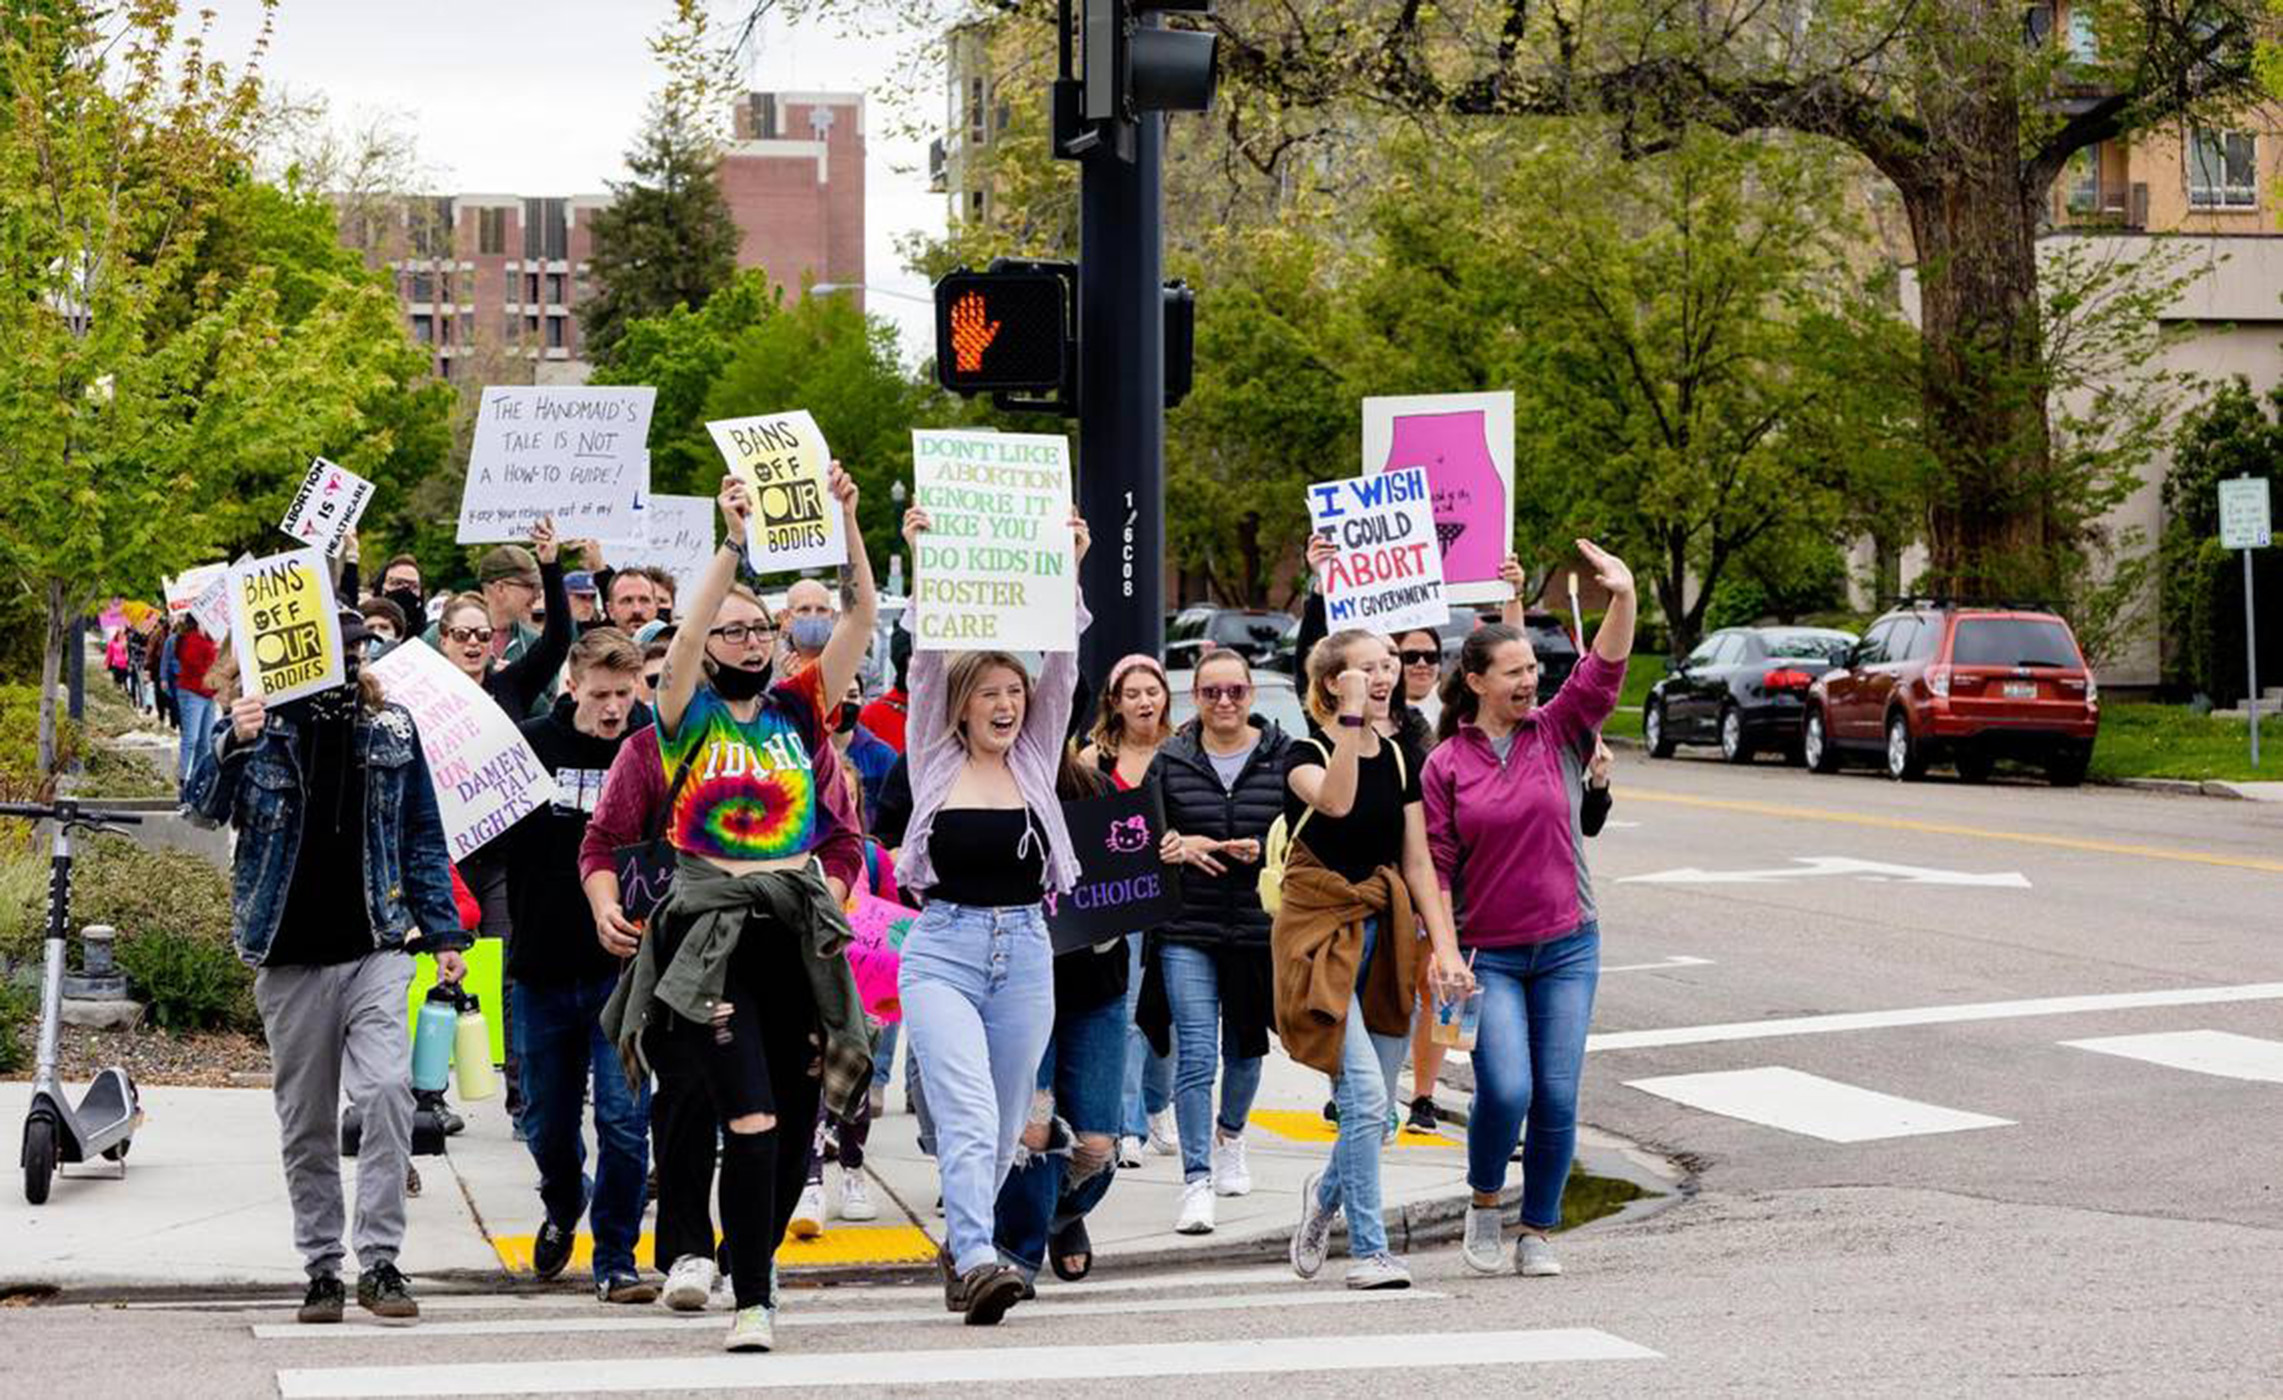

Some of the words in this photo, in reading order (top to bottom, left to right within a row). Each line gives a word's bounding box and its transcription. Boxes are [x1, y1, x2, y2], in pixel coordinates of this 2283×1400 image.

[492, 396, 523, 421] THE
[534, 396, 638, 422] HANDMAID'S
[503, 431, 543, 451] TALE
[554, 431, 568, 449] IS
[577, 431, 619, 452] NOT
[729, 421, 799, 457] BANS
[1000, 444, 1059, 465] LIKE
[480, 467, 491, 484] A
[570, 463, 624, 485] GUIDE!
[935, 462, 1062, 489] ABORTION
[284, 460, 326, 533] ABORTION
[317, 501, 336, 519] IS
[759, 481, 823, 523] OUR
[918, 486, 1013, 515] IGNORE
[1024, 496, 1052, 516] IT
[1313, 486, 1345, 518] I
[1350, 469, 1425, 509] WISH
[768, 523, 826, 553] BODIES
[989, 516, 1040, 541] YOU
[1343, 510, 1412, 550] COULD
[921, 547, 960, 570] DO
[967, 548, 1029, 573] KIDS
[1034, 550, 1064, 576] IN
[1327, 542, 1430, 594] ABORT
[243, 558, 305, 606] BANS
[921, 578, 1027, 606] FOSTER
[921, 614, 998, 639] CARE
[1329, 597, 1357, 621] MY
[255, 622, 321, 668] OUR
[261, 659, 324, 695] BODIES
[417, 692, 471, 738] ANNA
[425, 716, 481, 763] HAVE
[435, 756, 471, 790] UN
[456, 742, 528, 803] DAMEN
[493, 763, 538, 801] TAL
[454, 791, 536, 855] RIGHTS
[1074, 873, 1161, 909] CHOICE
